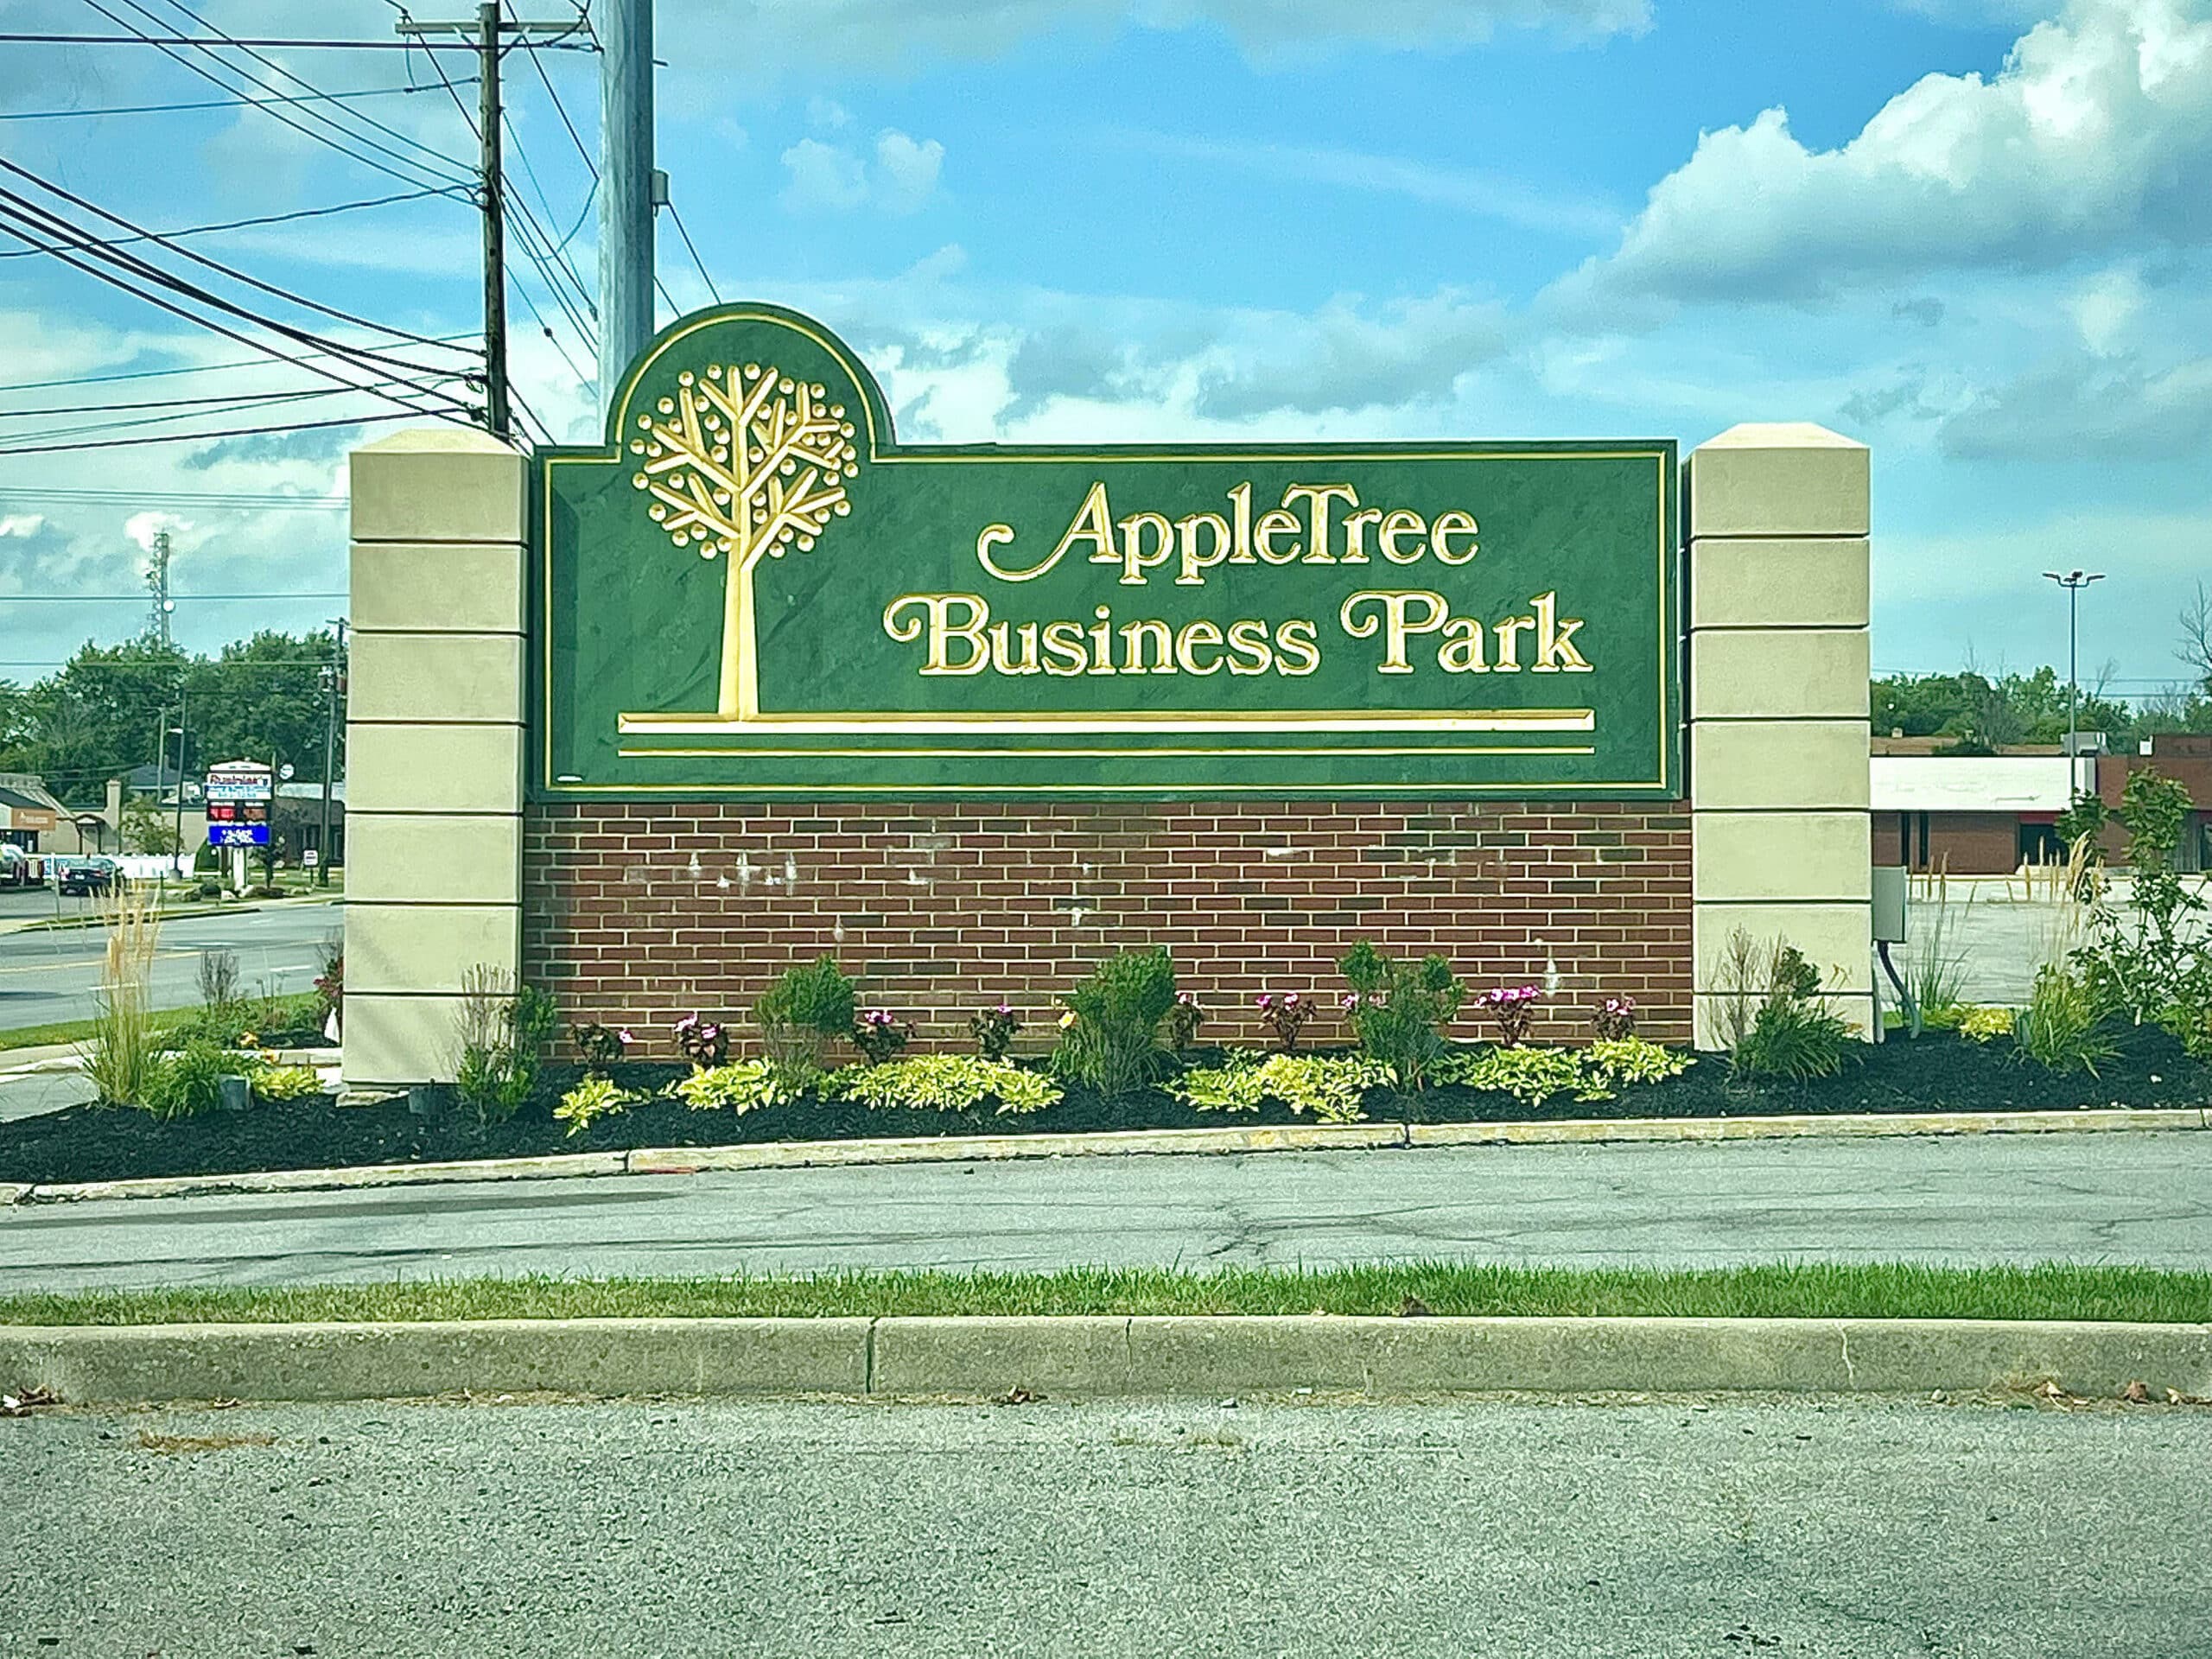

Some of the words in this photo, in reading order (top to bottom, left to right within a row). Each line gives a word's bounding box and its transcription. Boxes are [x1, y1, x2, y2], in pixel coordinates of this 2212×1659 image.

[978, 481, 1479, 585] AppleTree
[883, 592, 1321, 677] Business
[1340, 591, 1593, 674] Park
